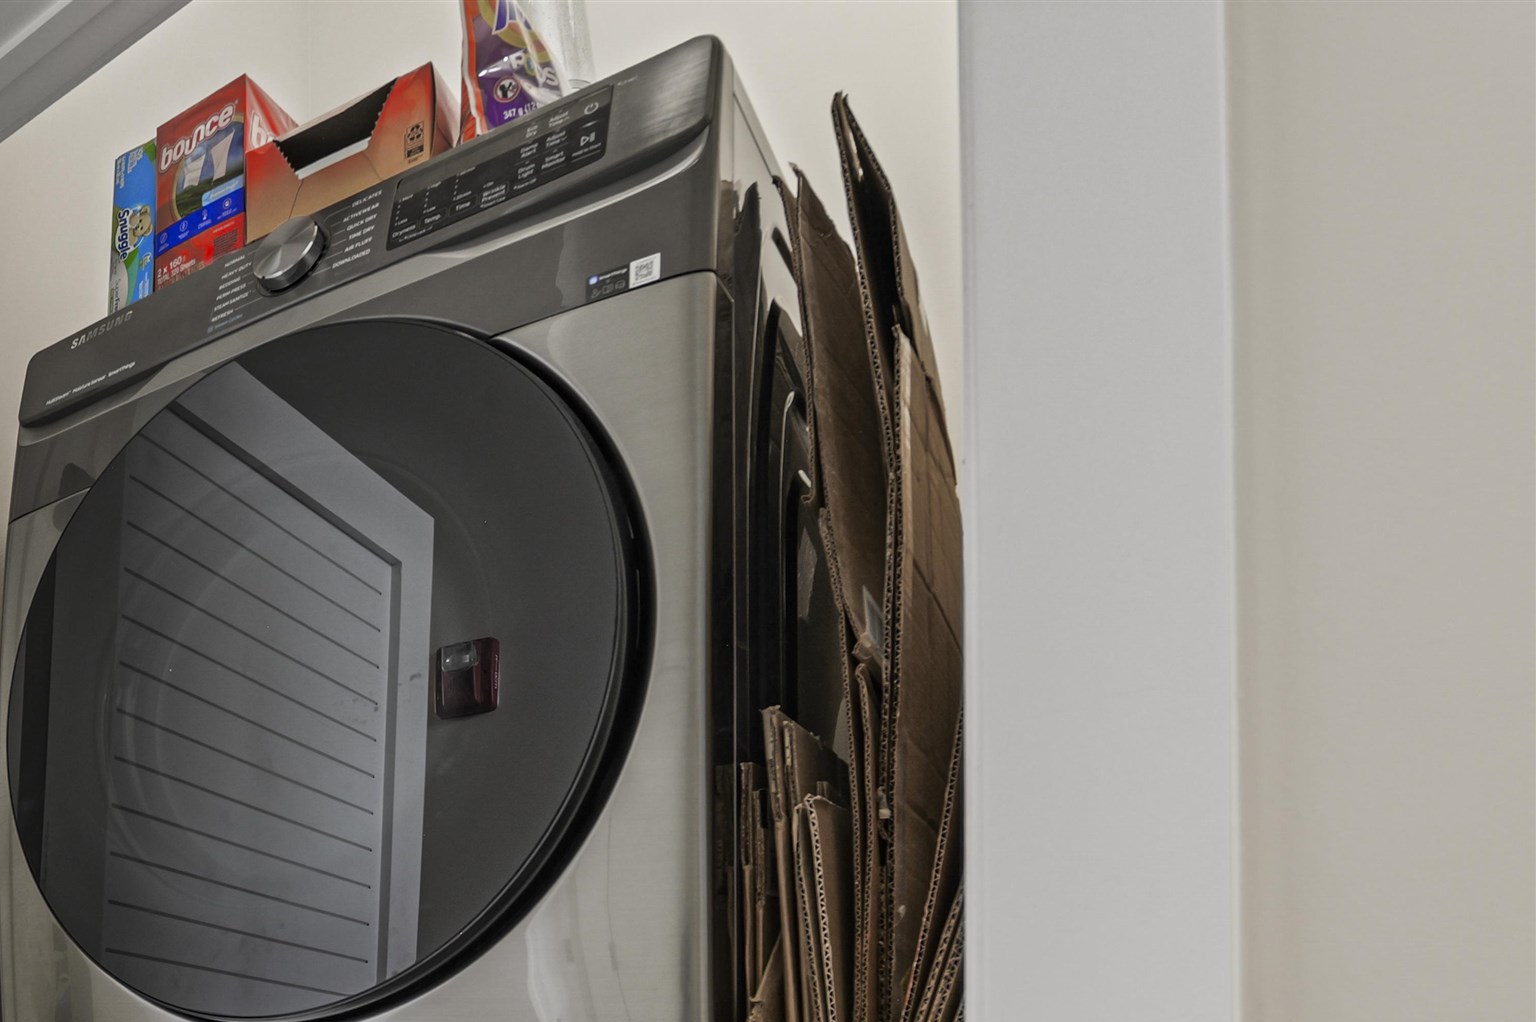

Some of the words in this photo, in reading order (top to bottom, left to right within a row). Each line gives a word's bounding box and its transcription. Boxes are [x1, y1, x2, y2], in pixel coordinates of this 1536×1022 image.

[503, 107, 517, 119] 347
[161, 104, 234, 170] bounce
[352, 190, 382, 207] DELICATES
[343, 203, 380, 222] ACTIVEWEAR
[346, 220, 364, 231] QUICK
[364, 213, 377, 224] DRY
[117, 208, 131, 261] Snuggle
[348, 231, 362, 240] TIME
[363, 225, 375, 235] DRY
[170, 256, 182, 269] 160
[332, 249, 371, 268] DOWNLOADED
[221, 268, 238, 280] HEAVY
[238, 262, 252, 273] DUTY
[71, 310, 133, 349] SAMSUNG
